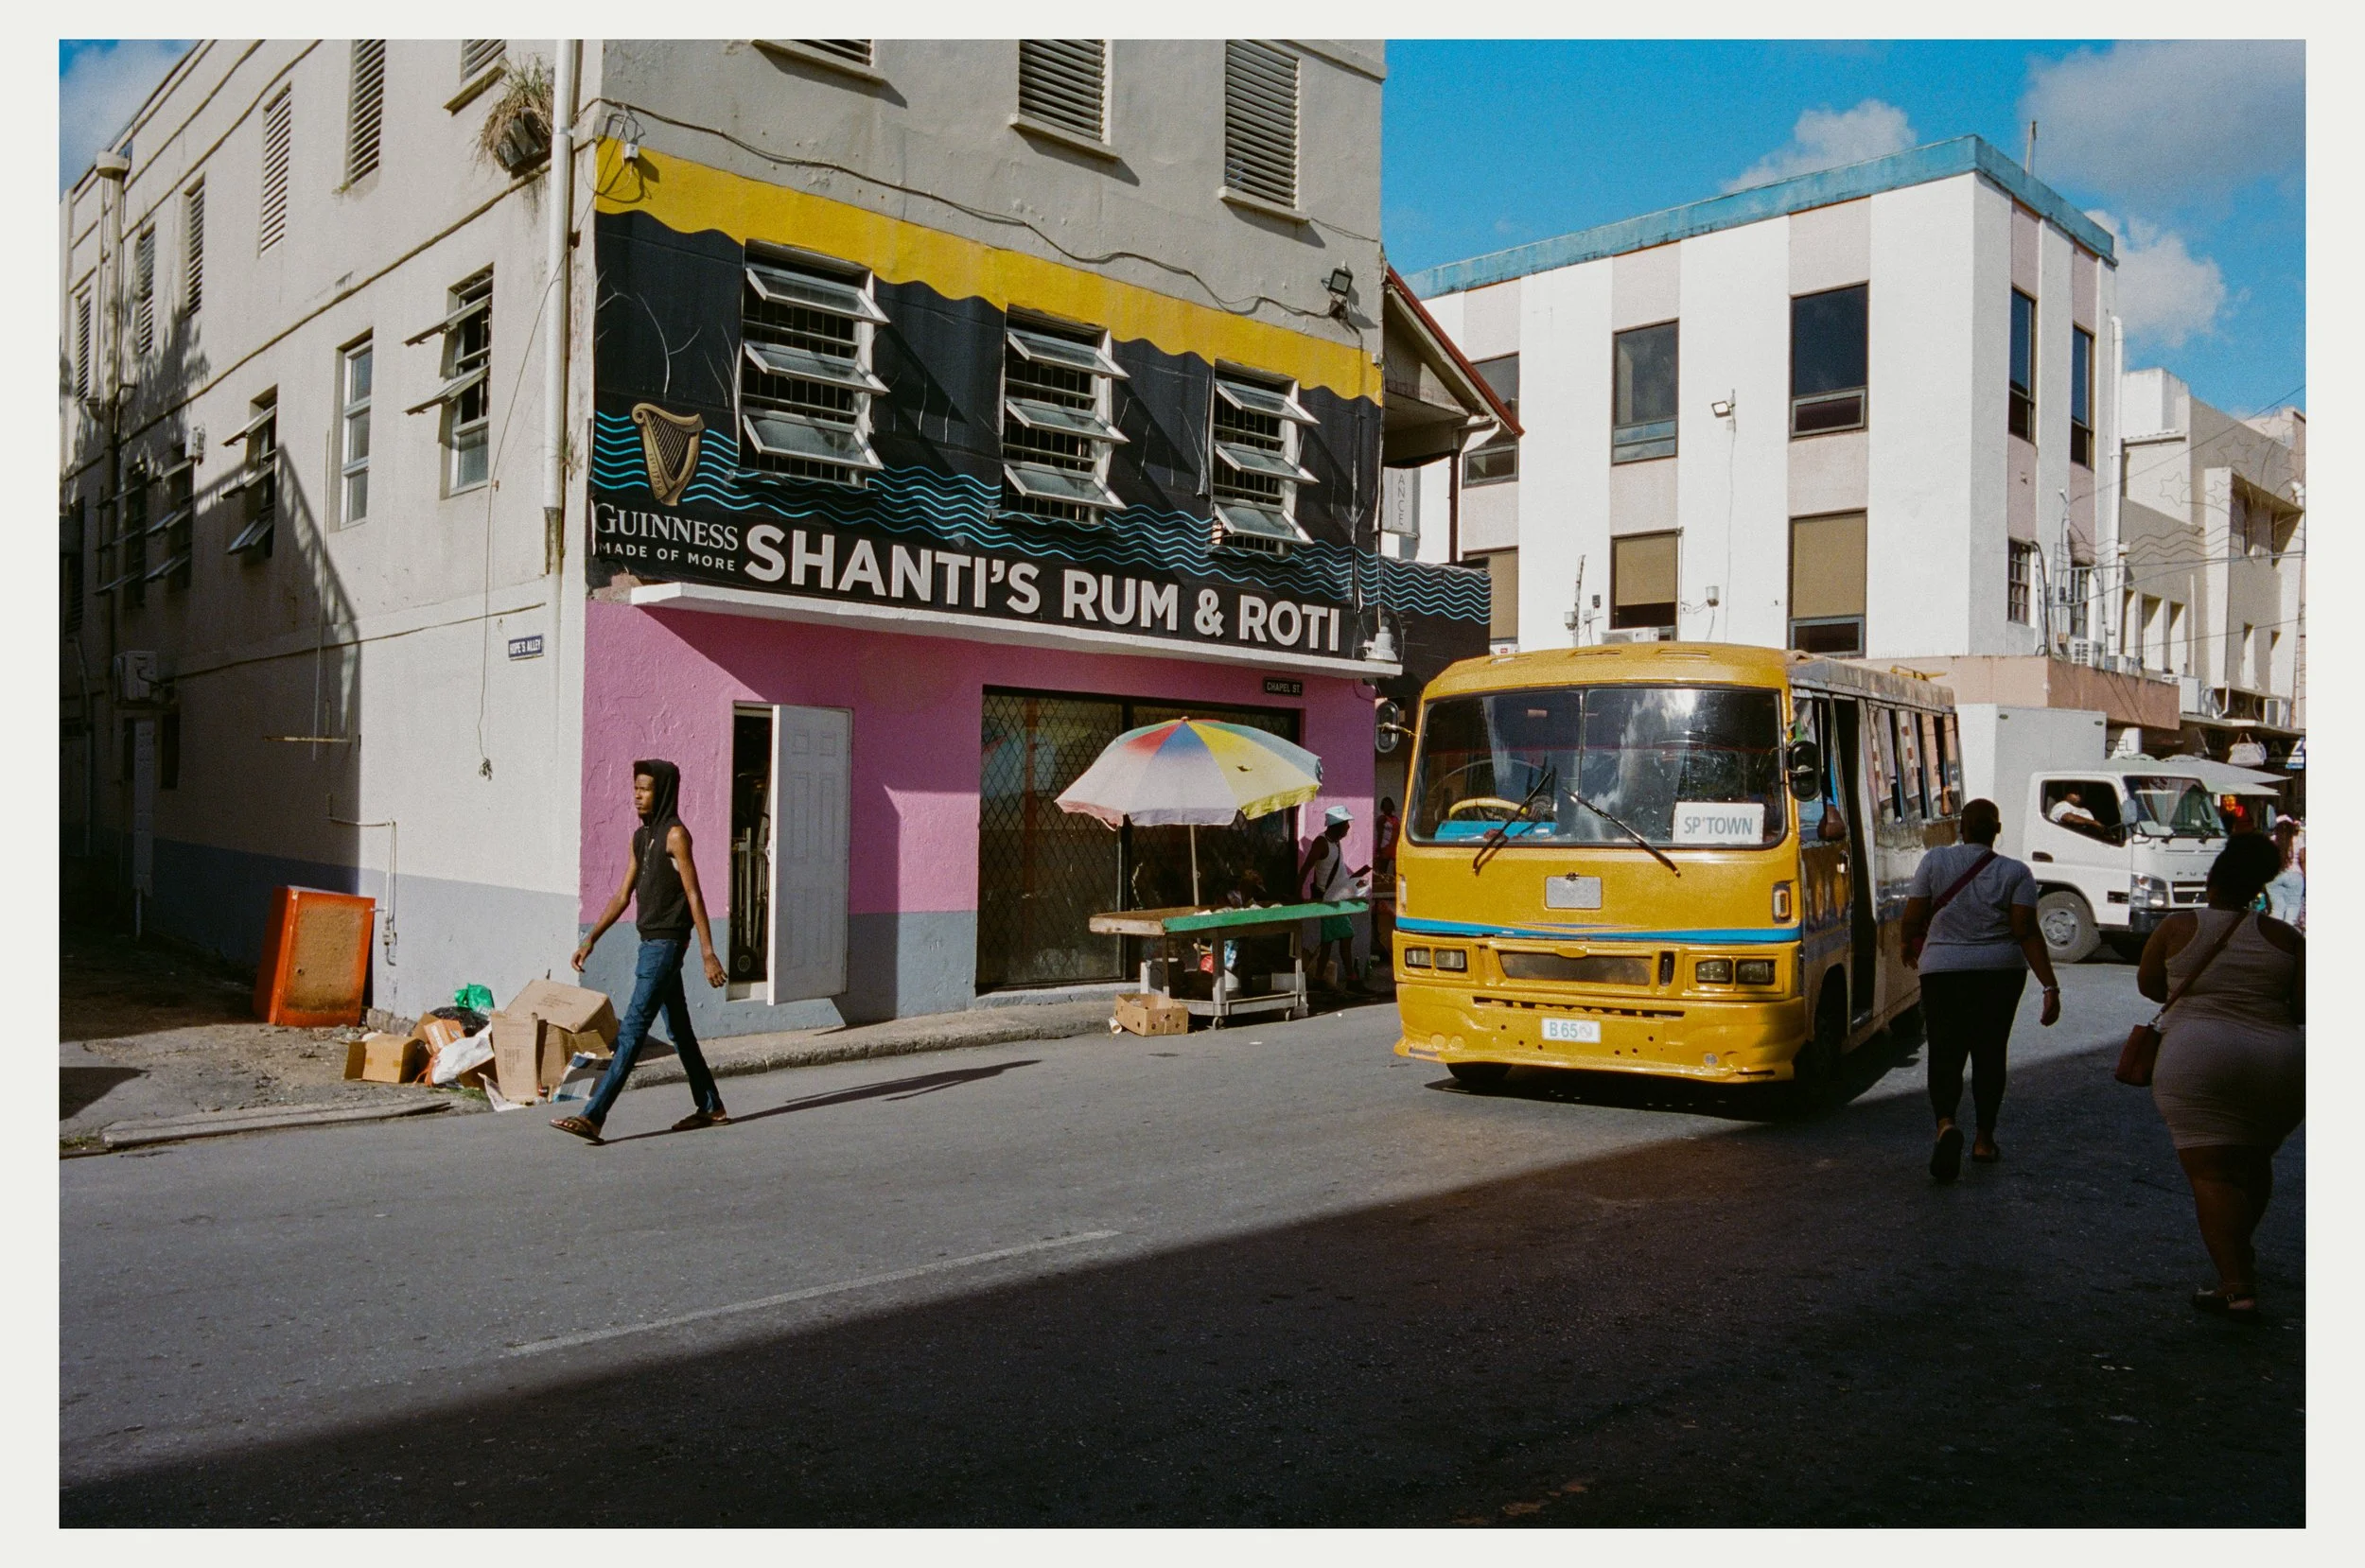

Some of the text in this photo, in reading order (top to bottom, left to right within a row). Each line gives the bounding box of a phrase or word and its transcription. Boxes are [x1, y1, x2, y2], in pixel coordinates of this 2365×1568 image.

[1397, 469, 1406, 526] ANCE
[595, 502, 739, 551] GUINNESS
[599, 542, 735, 572] MADE OF MORE
[744, 524, 1340, 653] SHANTI'S RUM & ROTI
[527, 638, 541, 652] ALLEY
[1267, 682, 1290, 692] CHAPEL
[1550, 1021, 1558, 1037] B
